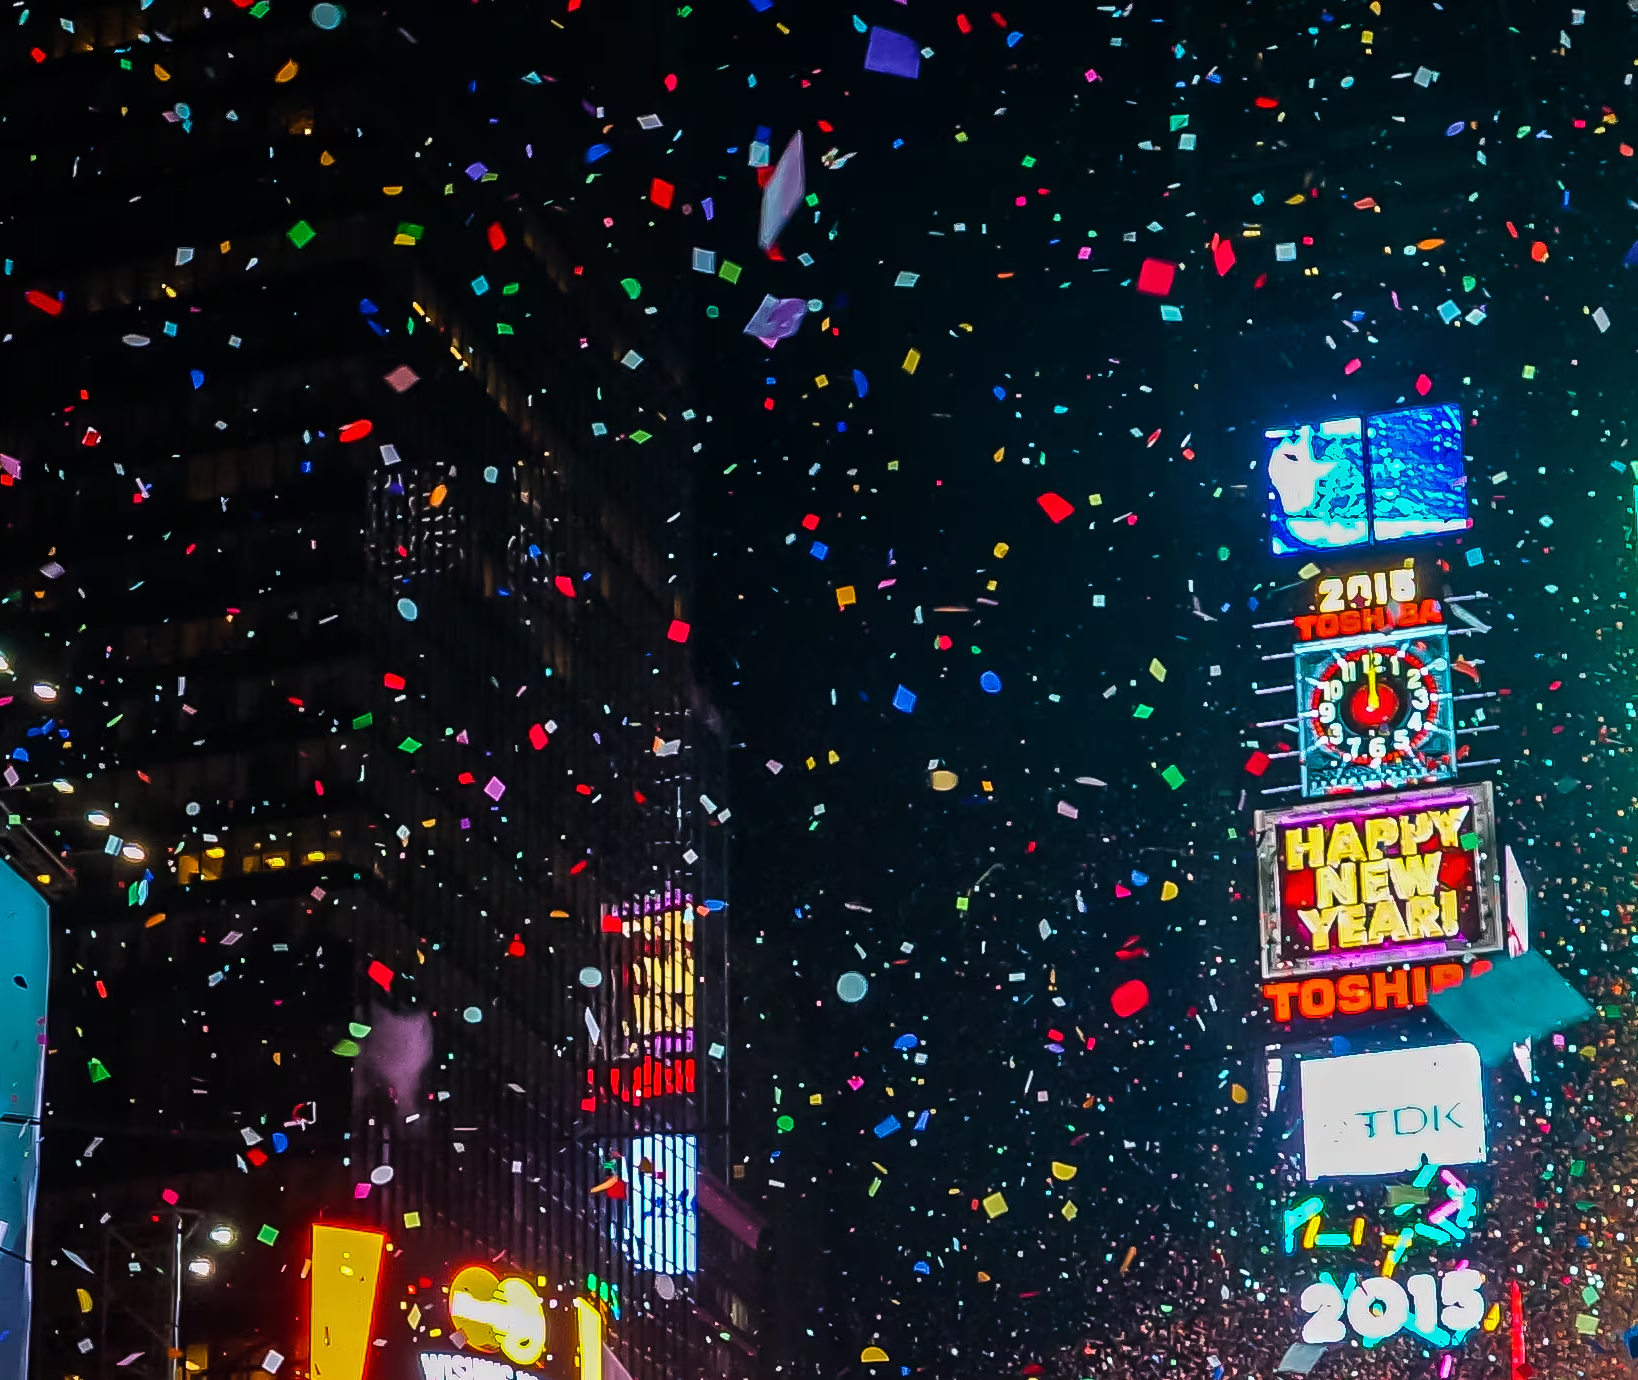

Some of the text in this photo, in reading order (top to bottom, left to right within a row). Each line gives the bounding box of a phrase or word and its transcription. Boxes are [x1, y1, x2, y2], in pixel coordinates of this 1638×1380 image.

[1318, 568, 1415, 613] 2015
[1284, 804, 1470, 873] HAPPY
[1315, 851, 1442, 908] NEW
[1297, 889, 1459, 951] YEAR!
[1263, 961, 1493, 1023] TOSHIB
[1354, 1101, 1466, 1140] TDK
[1300, 1268, 1485, 1344] 2015
